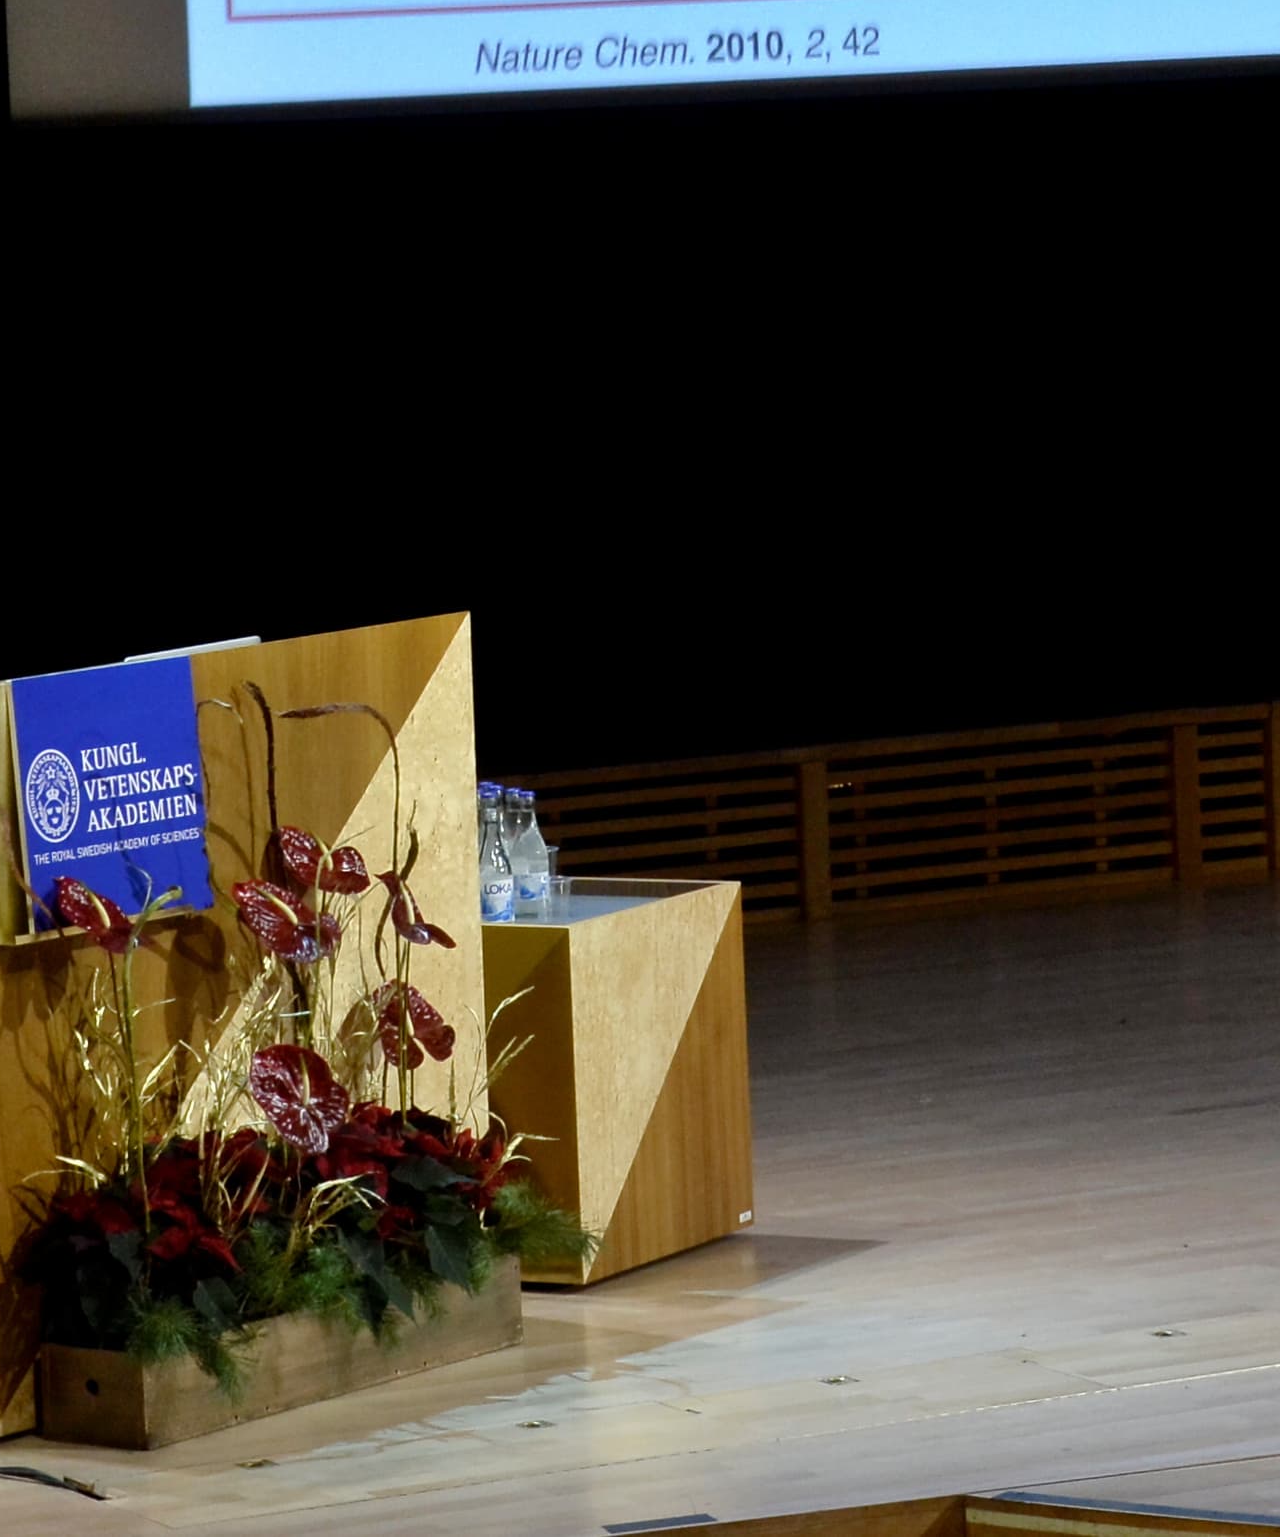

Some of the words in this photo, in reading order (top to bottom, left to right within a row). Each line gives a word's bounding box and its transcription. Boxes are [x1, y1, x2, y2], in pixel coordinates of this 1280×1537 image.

[475, 41, 583, 74] Nature
[595, 35, 696, 69] Chem.
[707, 30, 792, 63] 2010,
[805, 28, 831, 63] 2,
[842, 26, 880, 56] 42
[80, 741, 147, 772] KUNGL.
[83, 763, 198, 802] VETENSKAPS-
[86, 793, 198, 833] AKADEMIEN
[33, 853, 51, 866] THE
[51, 847, 76, 863] ROYAL
[77, 842, 113, 859] SWEDISH
[113, 836, 149, 853] ACADEMY
[150, 833, 161, 846] OF
[162, 827, 200, 845] SCIENCES
[484, 883, 513, 895] LOKA
